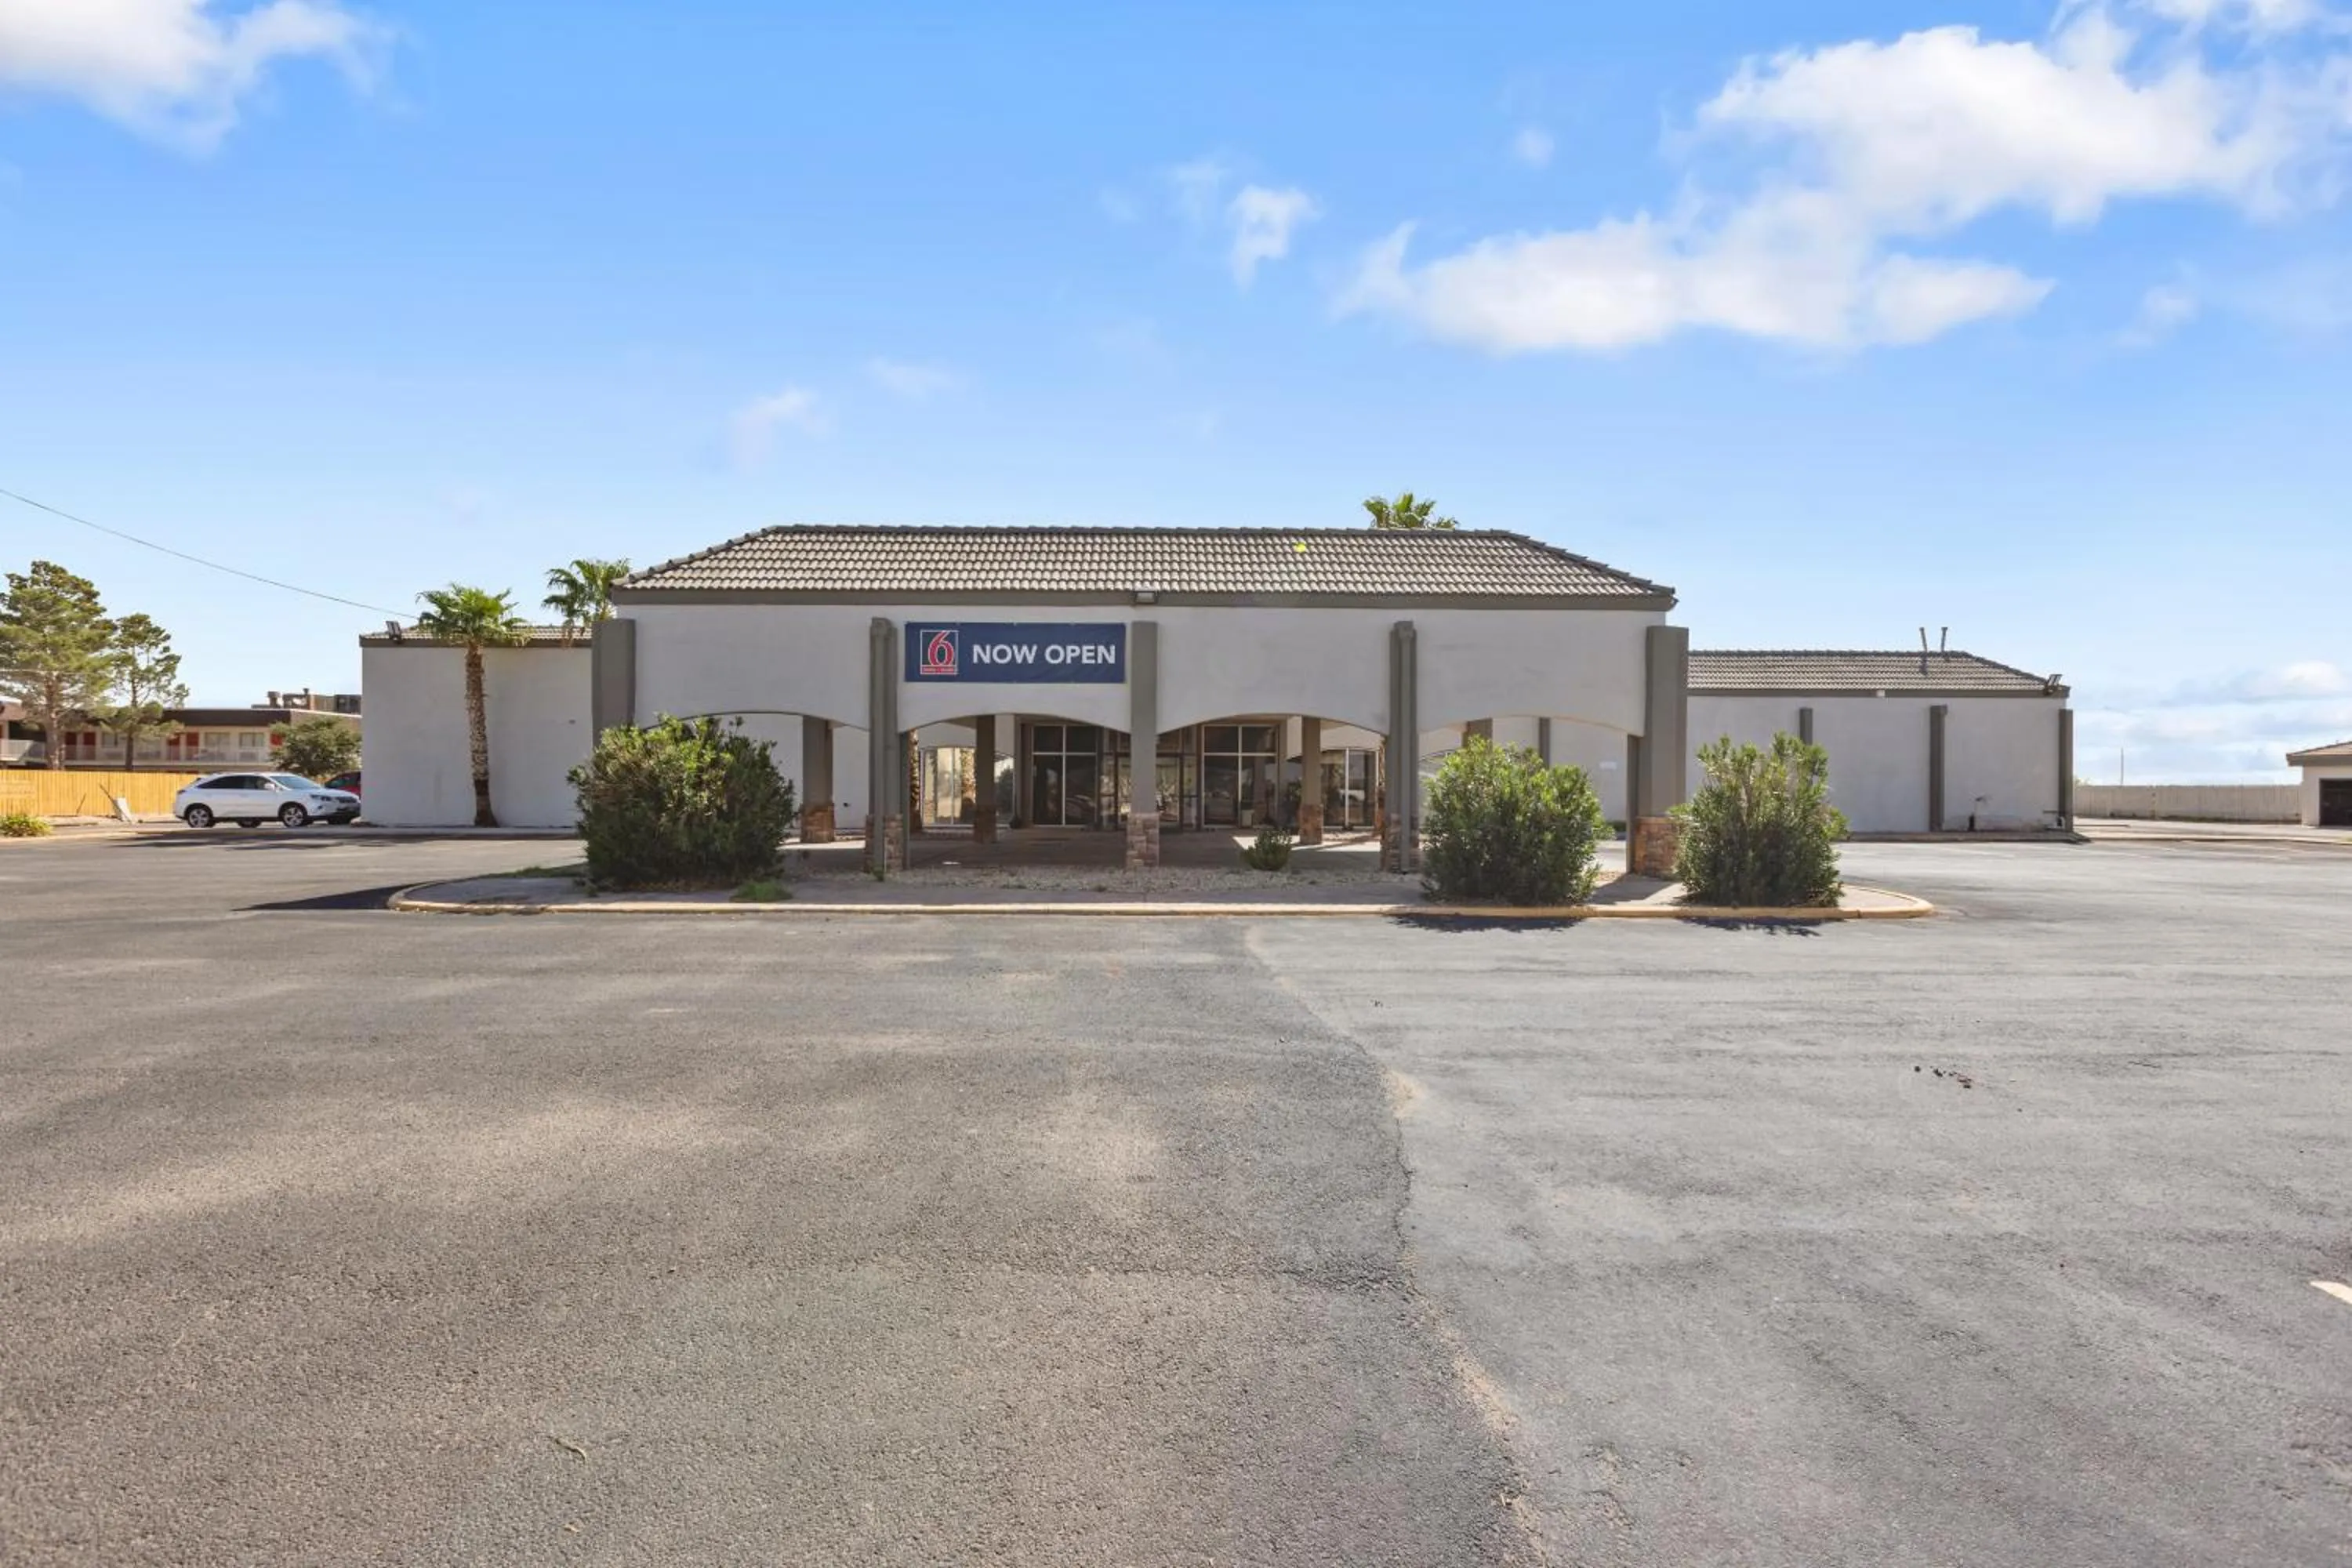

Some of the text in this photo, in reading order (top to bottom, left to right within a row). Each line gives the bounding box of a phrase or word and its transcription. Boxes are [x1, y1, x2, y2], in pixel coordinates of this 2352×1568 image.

[927, 630, 954, 666] 6
[972, 644, 1116, 664] NOW OPEN
